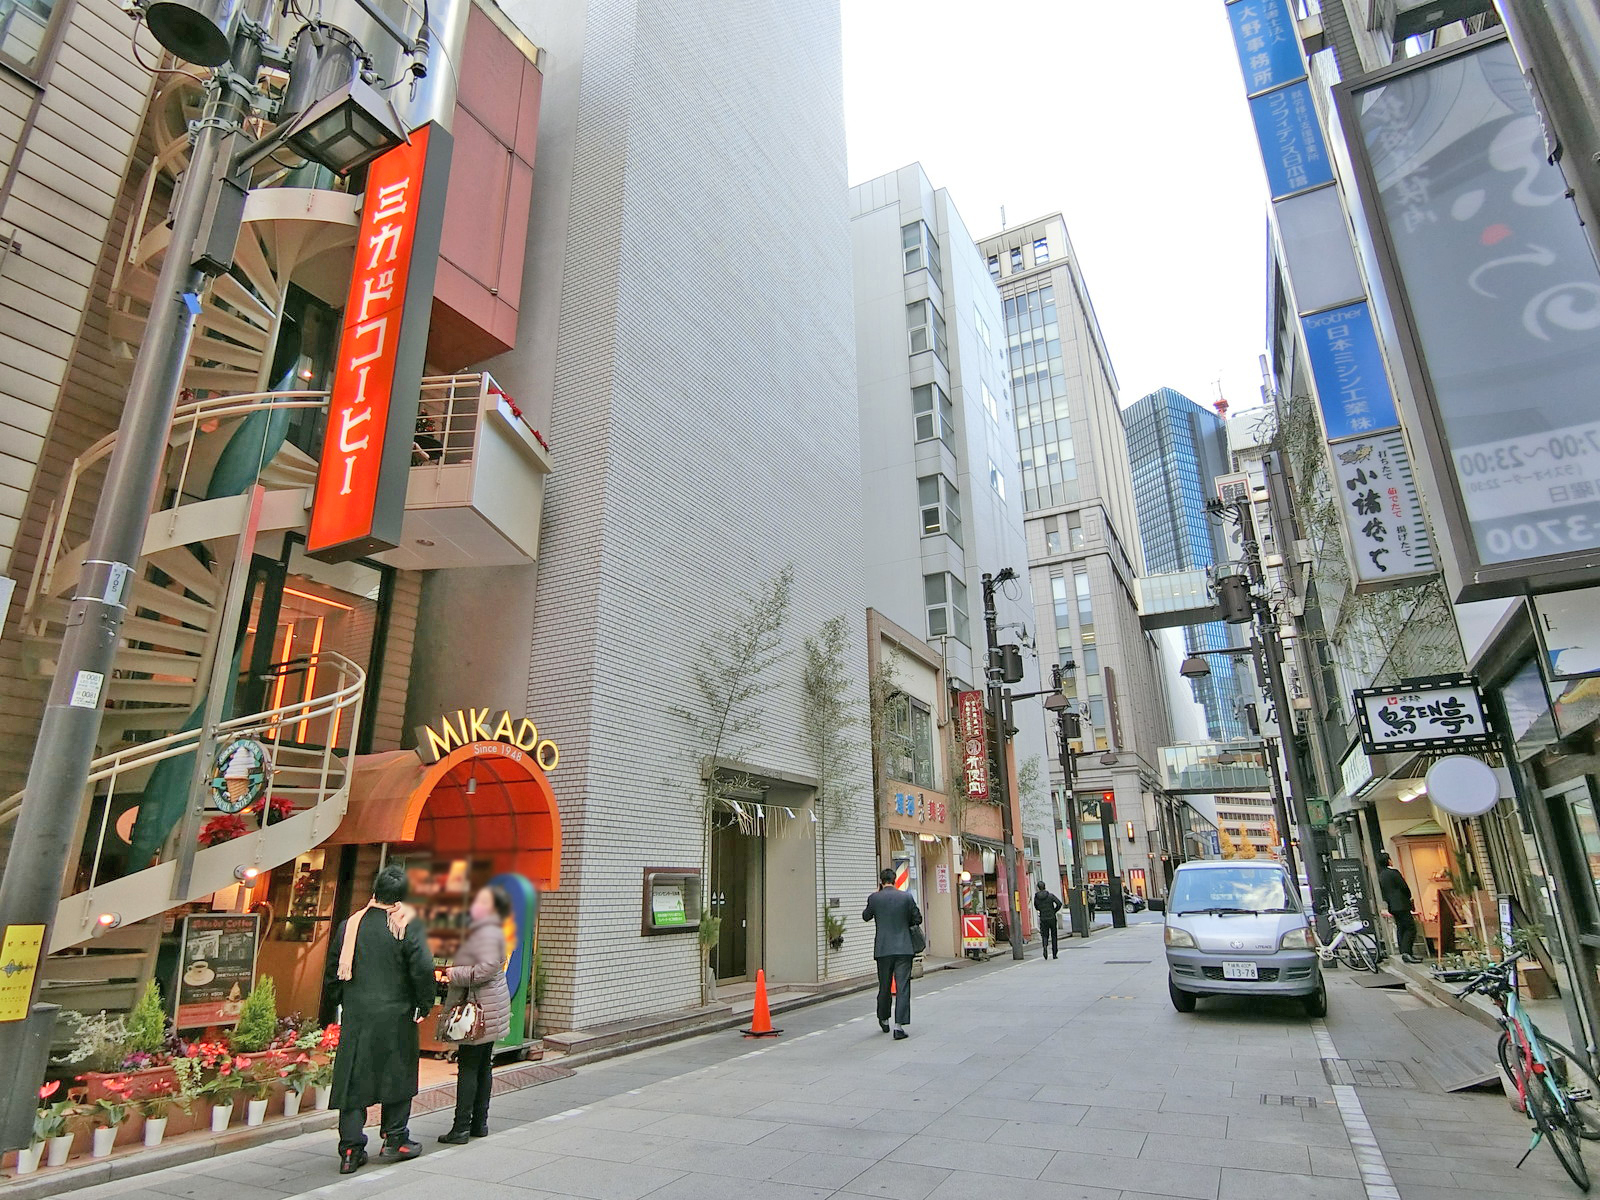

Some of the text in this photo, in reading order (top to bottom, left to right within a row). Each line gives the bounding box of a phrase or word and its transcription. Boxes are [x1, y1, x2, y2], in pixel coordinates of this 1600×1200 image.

[1238, 6, 1273, 87] 大野事務所
[1306, 308, 1363, 329] brother
[340, 176, 410, 495] ミカドコーヒー
[1378, 450, 1392, 480] 打ちたて
[1396, 525, 1412, 557] 揚げたて
[425, 707, 560, 771] MIKADO
[473, 744, 522, 762] Since 1948
[1232, 968, 1256, 977] 13-78
